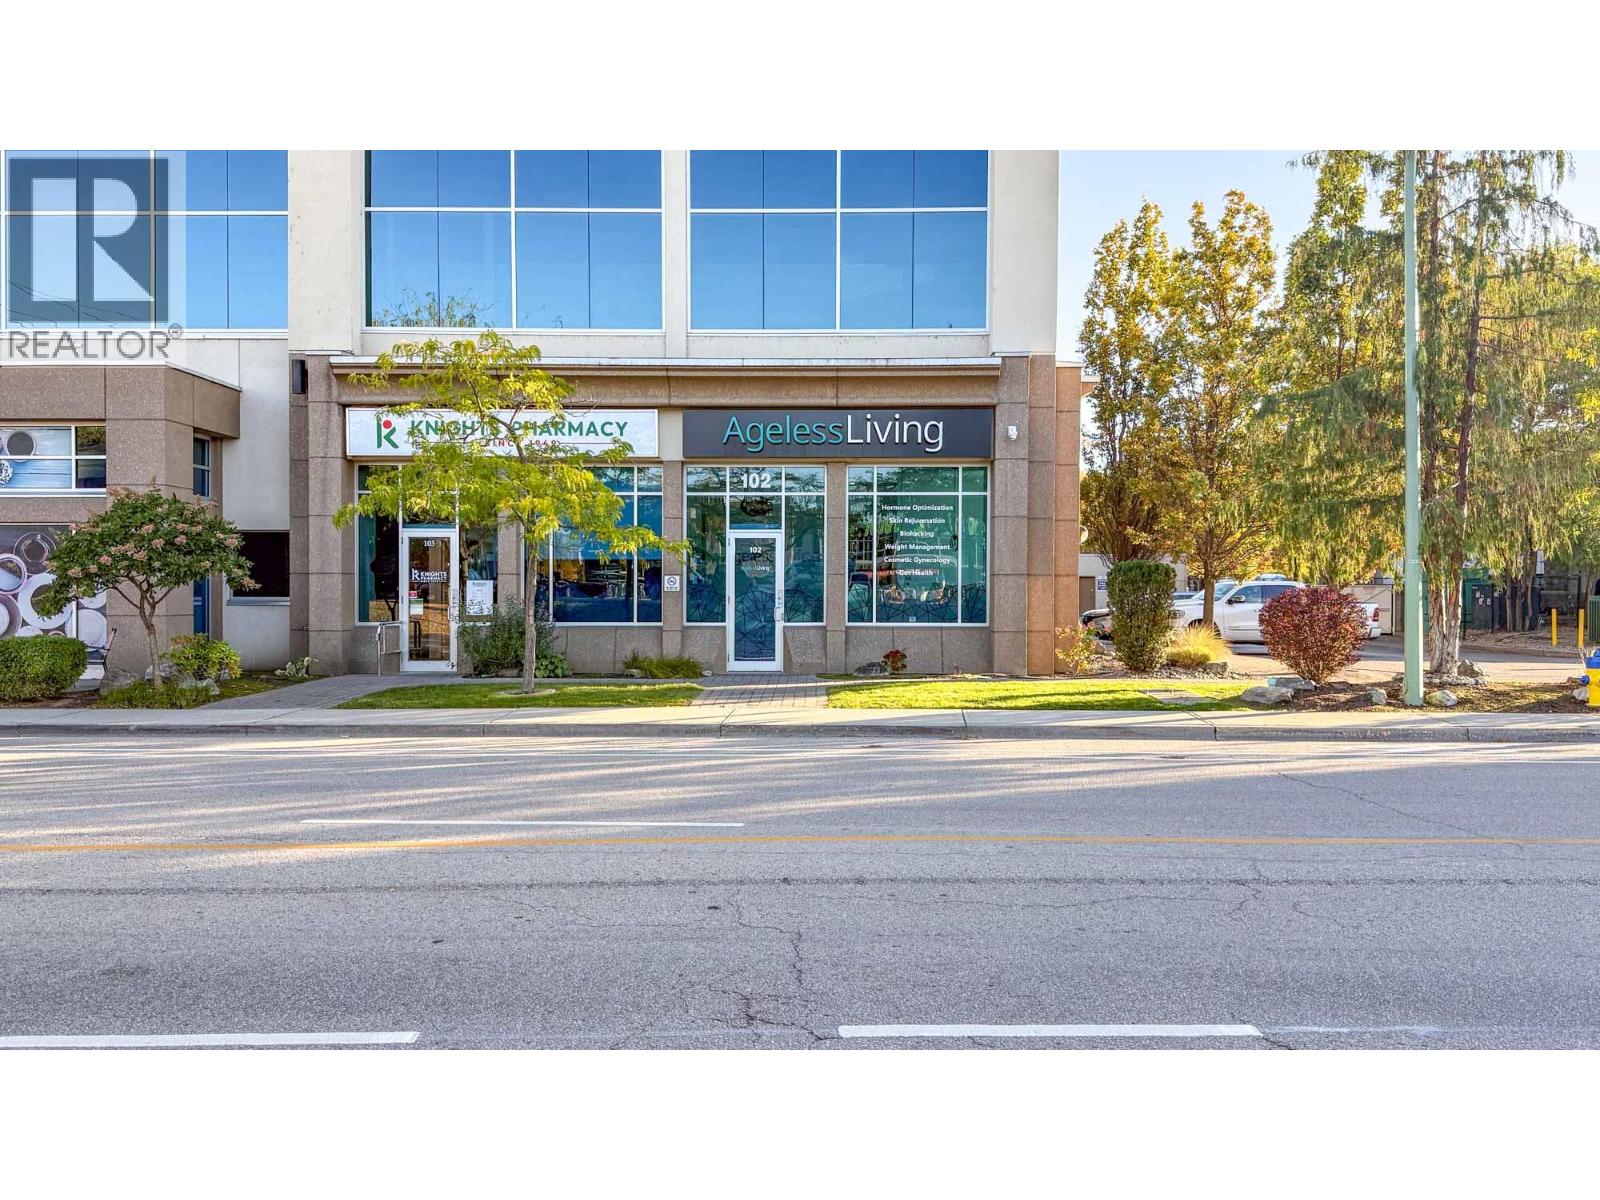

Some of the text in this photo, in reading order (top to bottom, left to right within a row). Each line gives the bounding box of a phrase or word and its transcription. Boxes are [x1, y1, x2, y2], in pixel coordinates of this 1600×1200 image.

[513, 421, 628, 437] PHARMACY
[741, 473, 771, 489] 102
[912, 504, 953, 512] Optimization
[904, 517, 946, 525] Rejuvenation
[750, 546, 762, 554] 102
[884, 543, 950, 551] Weight Management
[913, 556, 951, 564] Gynecology
